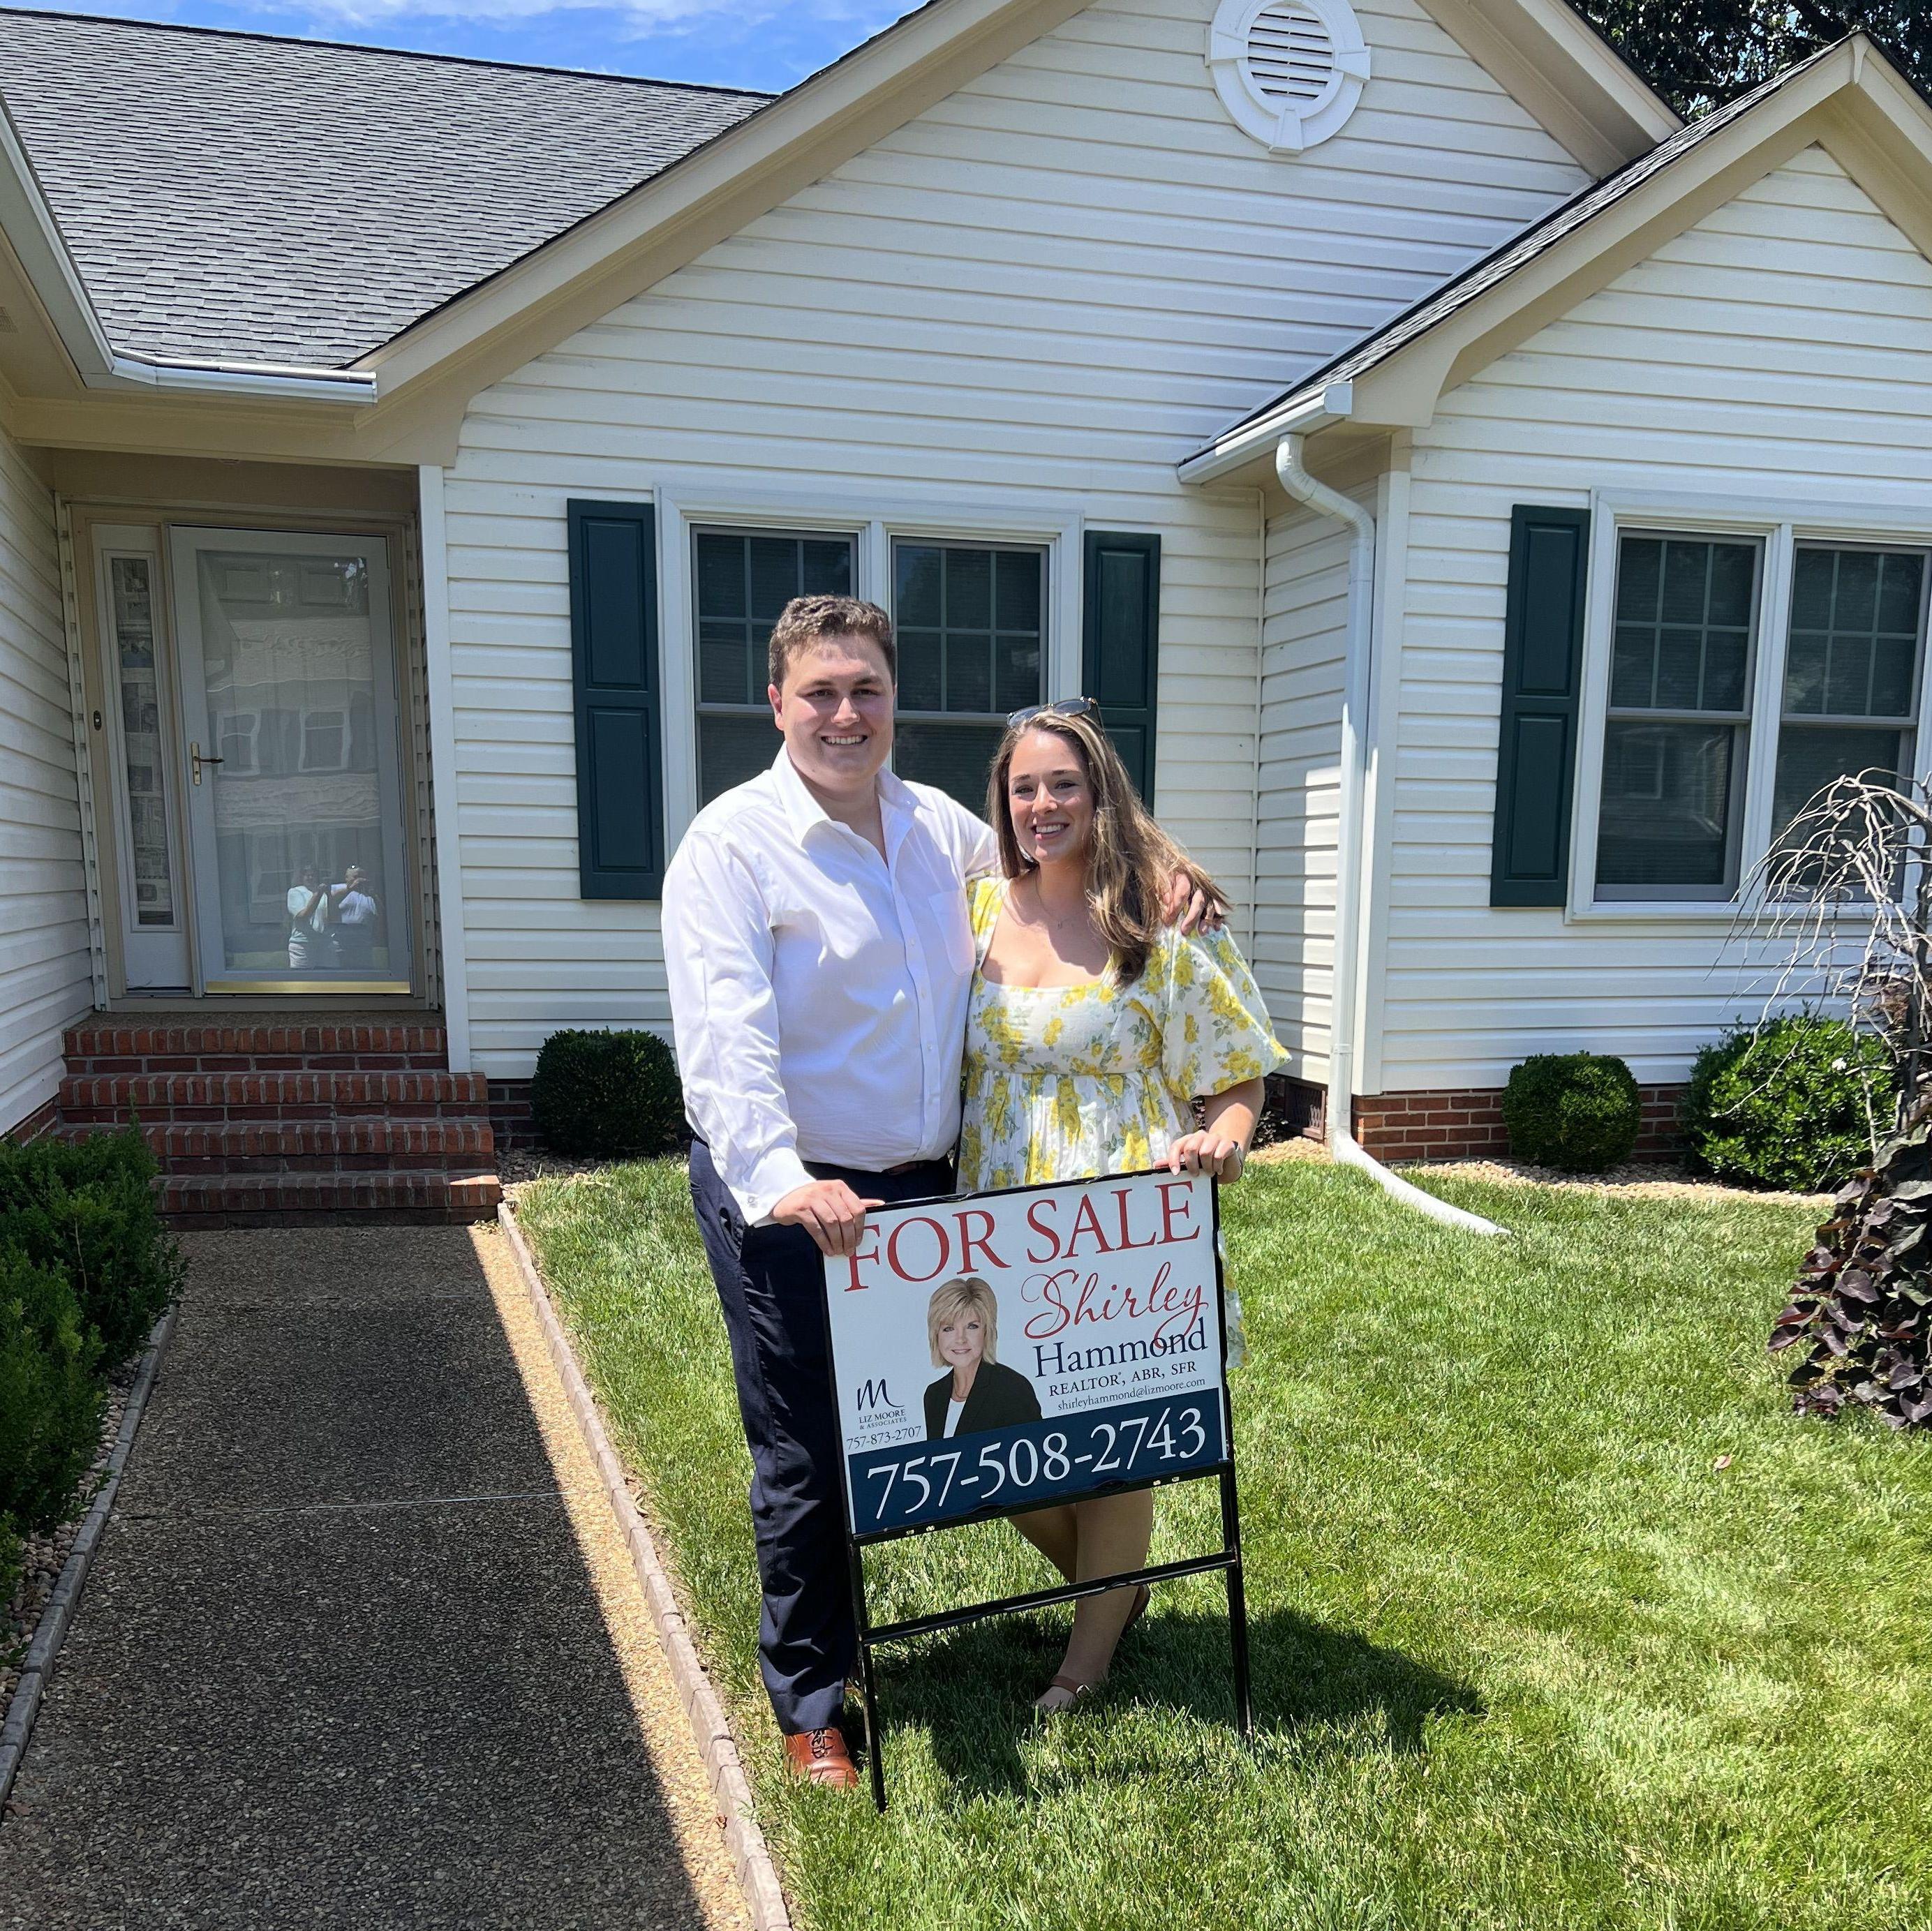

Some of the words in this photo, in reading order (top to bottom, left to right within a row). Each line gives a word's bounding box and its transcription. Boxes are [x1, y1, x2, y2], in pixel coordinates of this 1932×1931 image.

[844, 1210, 1012, 1292] FOR
[1026, 1180, 1201, 1265] SALE
[1020, 1261, 1209, 1349] Shirley
[1032, 1316, 1209, 1378] Hammond
[1131, 1366, 1165, 1382] ABR,
[1171, 1361, 1197, 1375] SFR
[1057, 1378, 1205, 1410] shirleyhammond@lizmoore.com
[859, 1415, 872, 1424] LIZ
[874, 1409, 906, 1422] MOORE
[867, 1416, 907, 1429] ASSOCIATES
[846, 1425, 922, 1450] 757-873-2707
[867, 1407, 1206, 1520] 757-508-2743
